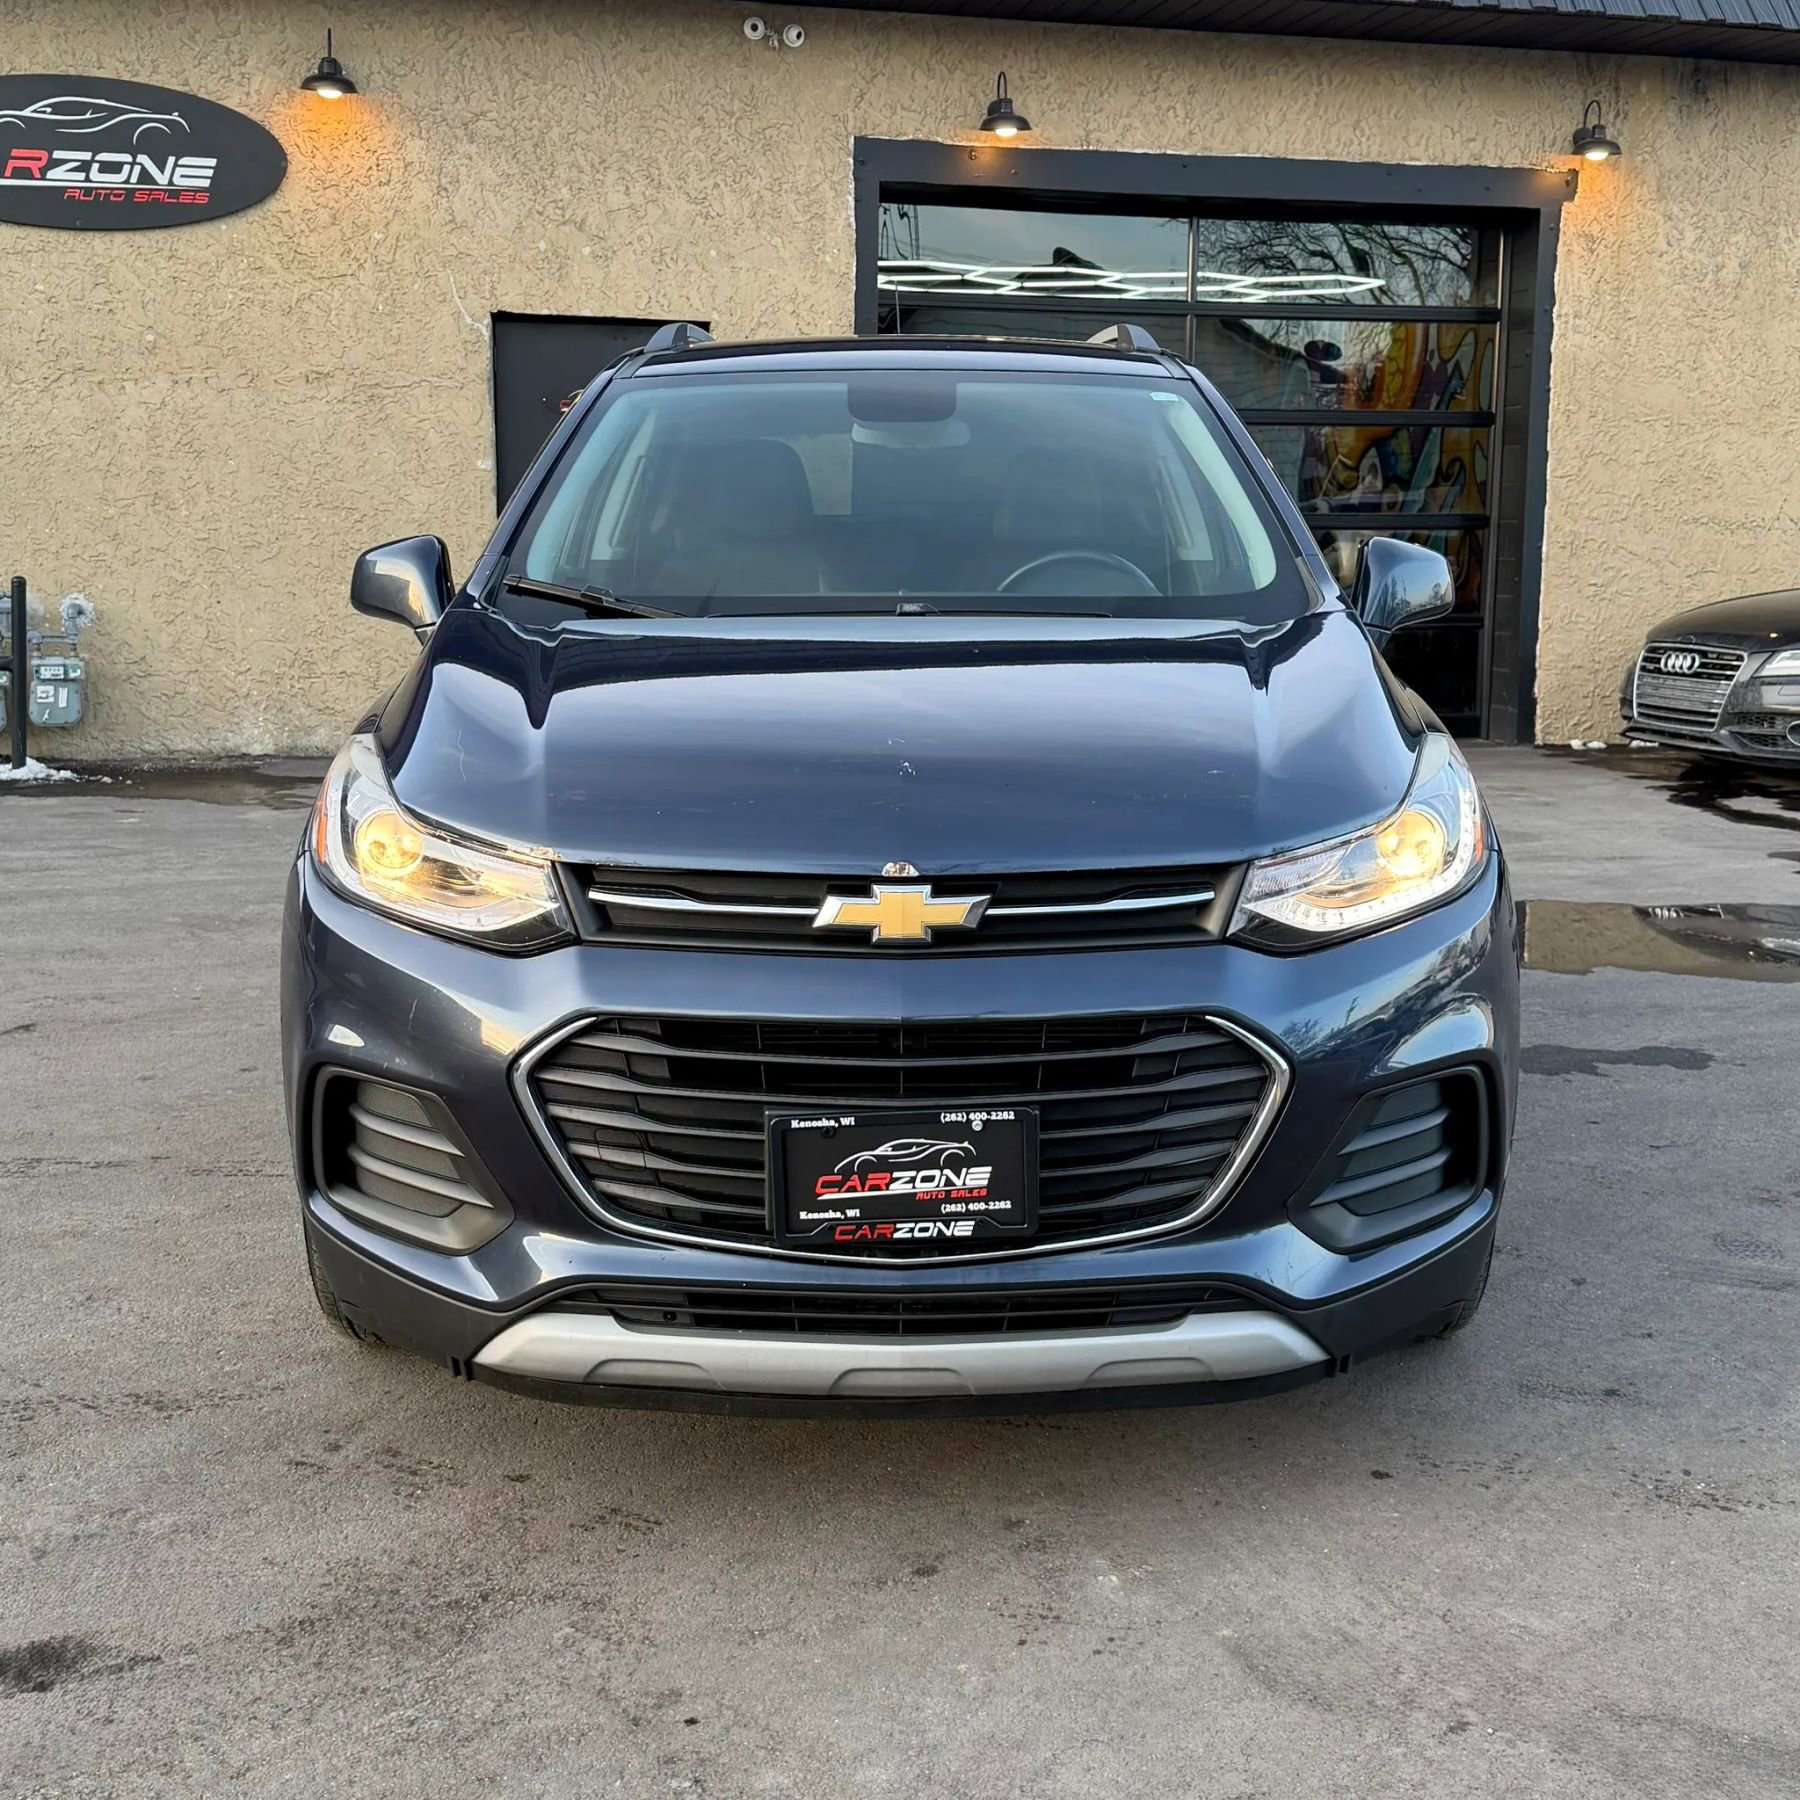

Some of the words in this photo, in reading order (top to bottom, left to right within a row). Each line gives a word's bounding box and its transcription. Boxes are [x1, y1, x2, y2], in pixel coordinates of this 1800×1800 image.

[63, 188, 125, 202] AUTO
[132, 191, 210, 204] SALES
[840, 1116, 856, 1126] WI
[940, 1112, 966, 1123] (262)
[815, 1166, 992, 1193] CARZONE
[916, 1190, 946, 1200] AUTO
[949, 1188, 988, 1198] SALES
[845, 1208, 861, 1218] WI
[940, 1202, 967, 1214] (262)
[834, 1221, 976, 1242] CARZONE
